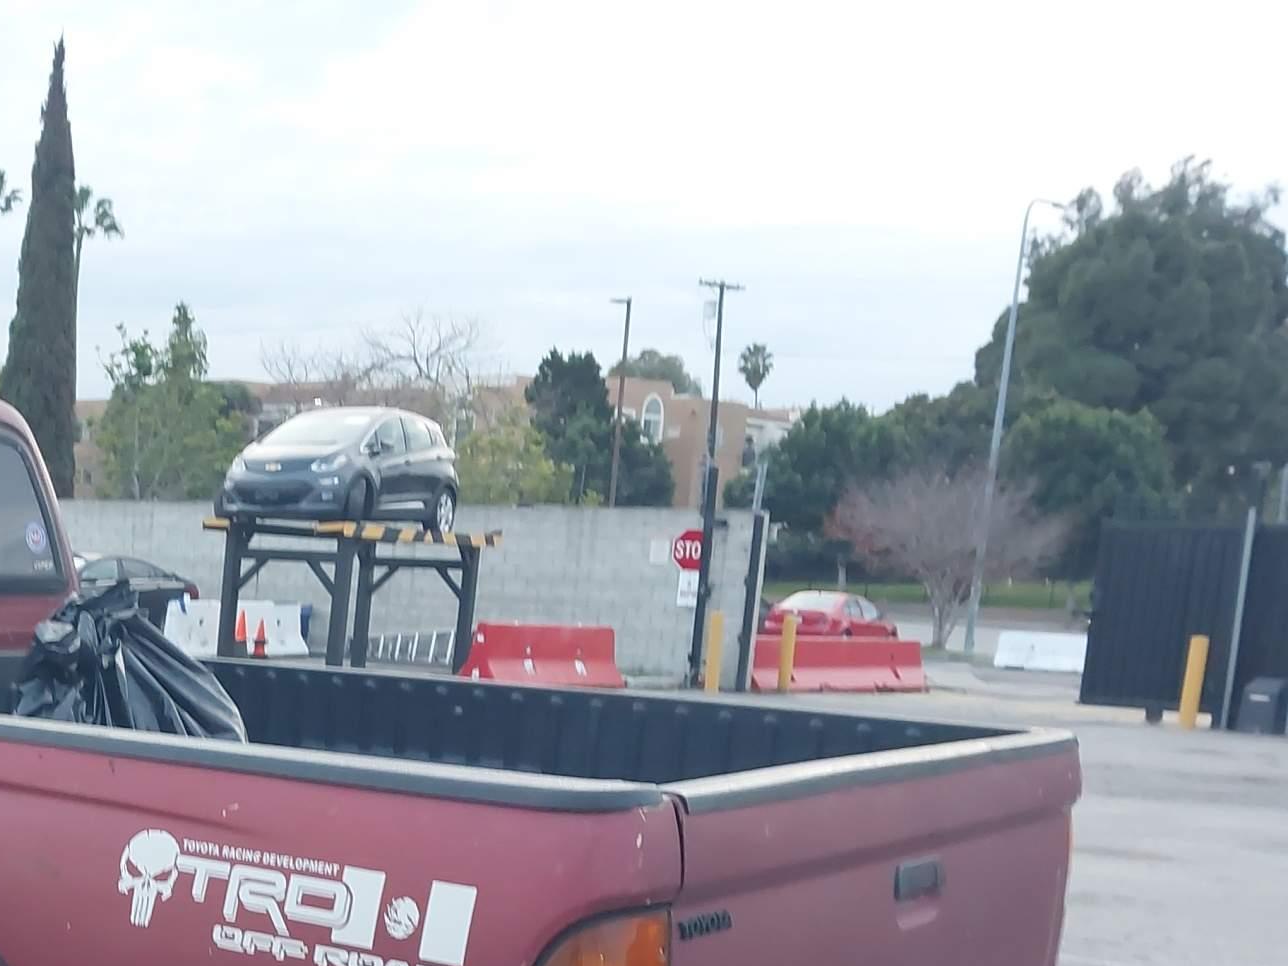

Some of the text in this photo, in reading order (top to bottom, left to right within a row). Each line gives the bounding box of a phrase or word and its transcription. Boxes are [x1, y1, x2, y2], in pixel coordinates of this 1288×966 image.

[675, 539, 702, 560] STO
[183, 838, 340, 877] TOYOTA RACING DEVELOPMENT
[177, 853, 351, 938] TRD
[212, 924, 309, 962] OFF
[677, 910, 732, 940] TOYOTA
